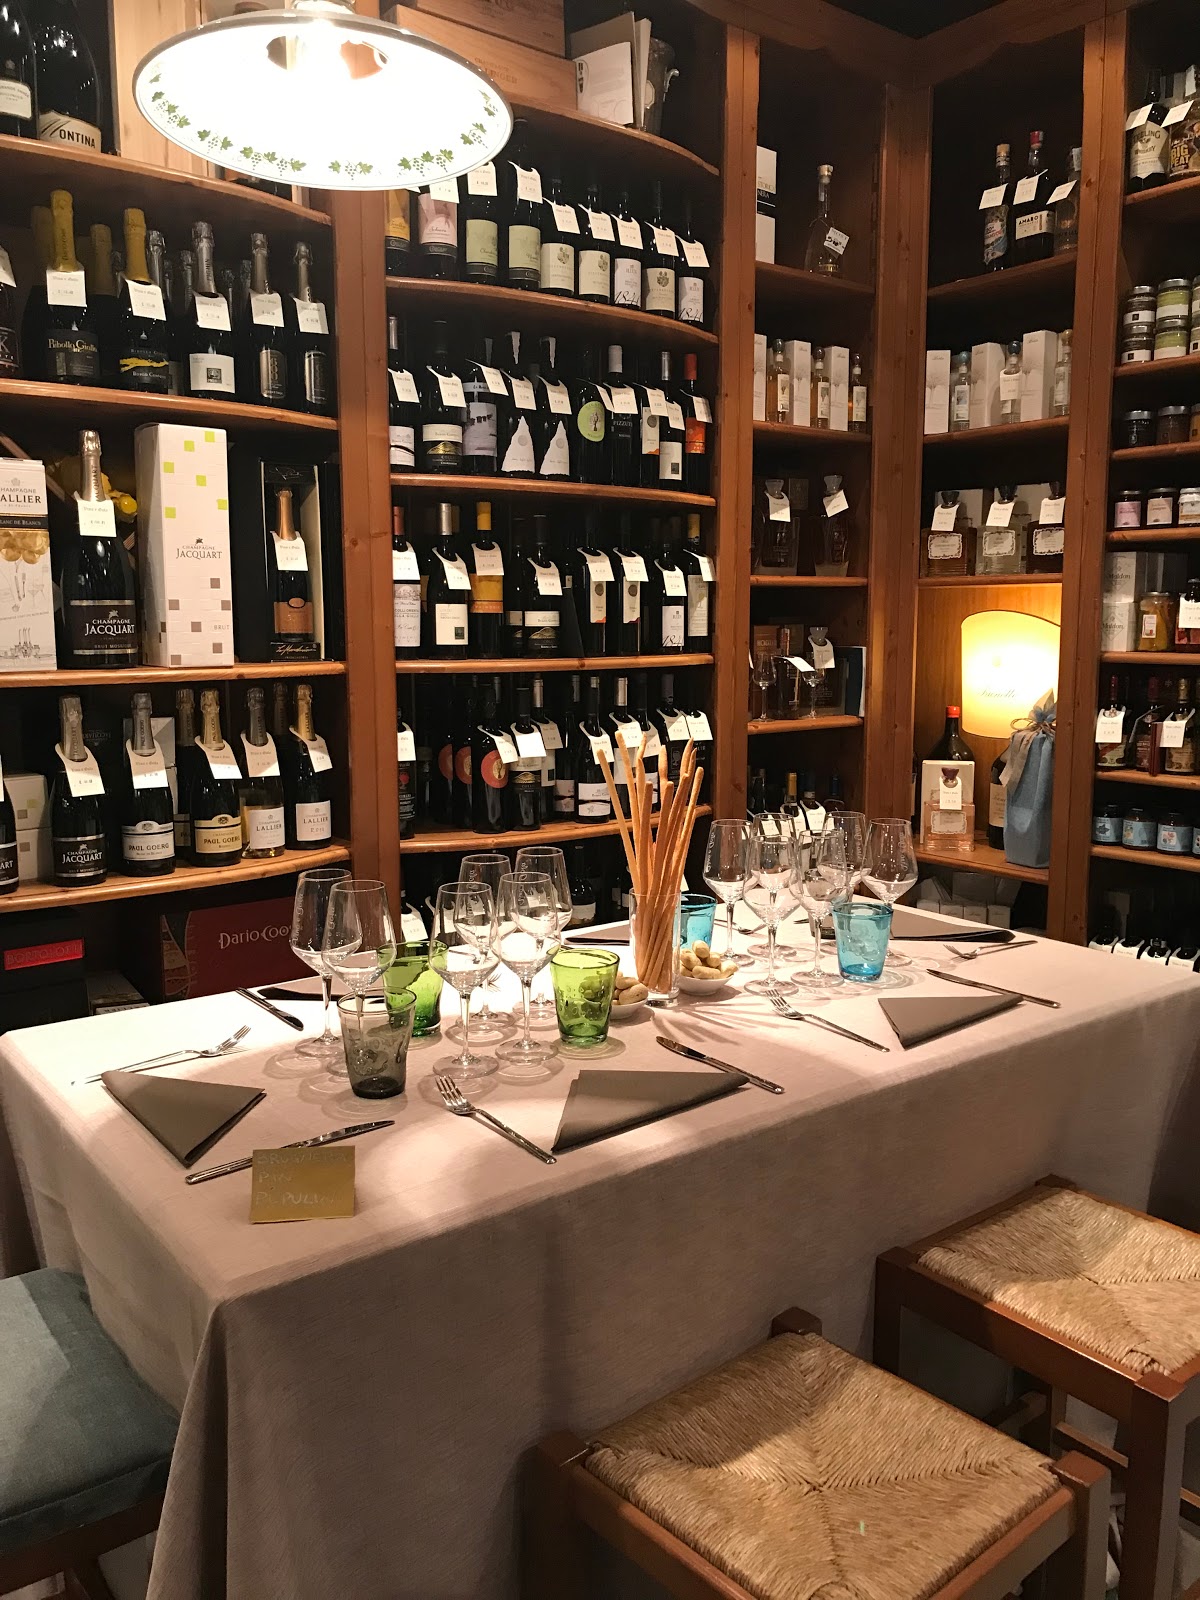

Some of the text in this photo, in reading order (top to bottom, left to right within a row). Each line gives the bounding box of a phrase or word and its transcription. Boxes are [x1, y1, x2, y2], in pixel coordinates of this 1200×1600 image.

[1171, 144, 1189, 158] BIG
[0, 494, 41, 504] ALLIER
[176, 548, 222, 560] JACQUART
[85, 623, 135, 636] JACQUART
[303, 816, 329, 824] LALLIER
[256, 823, 282, 832] LALLIER
[146, 842, 169, 850] GOERG
[62, 852, 103, 865] JACQUART
[219, 925, 293, 949] Dario Coo
